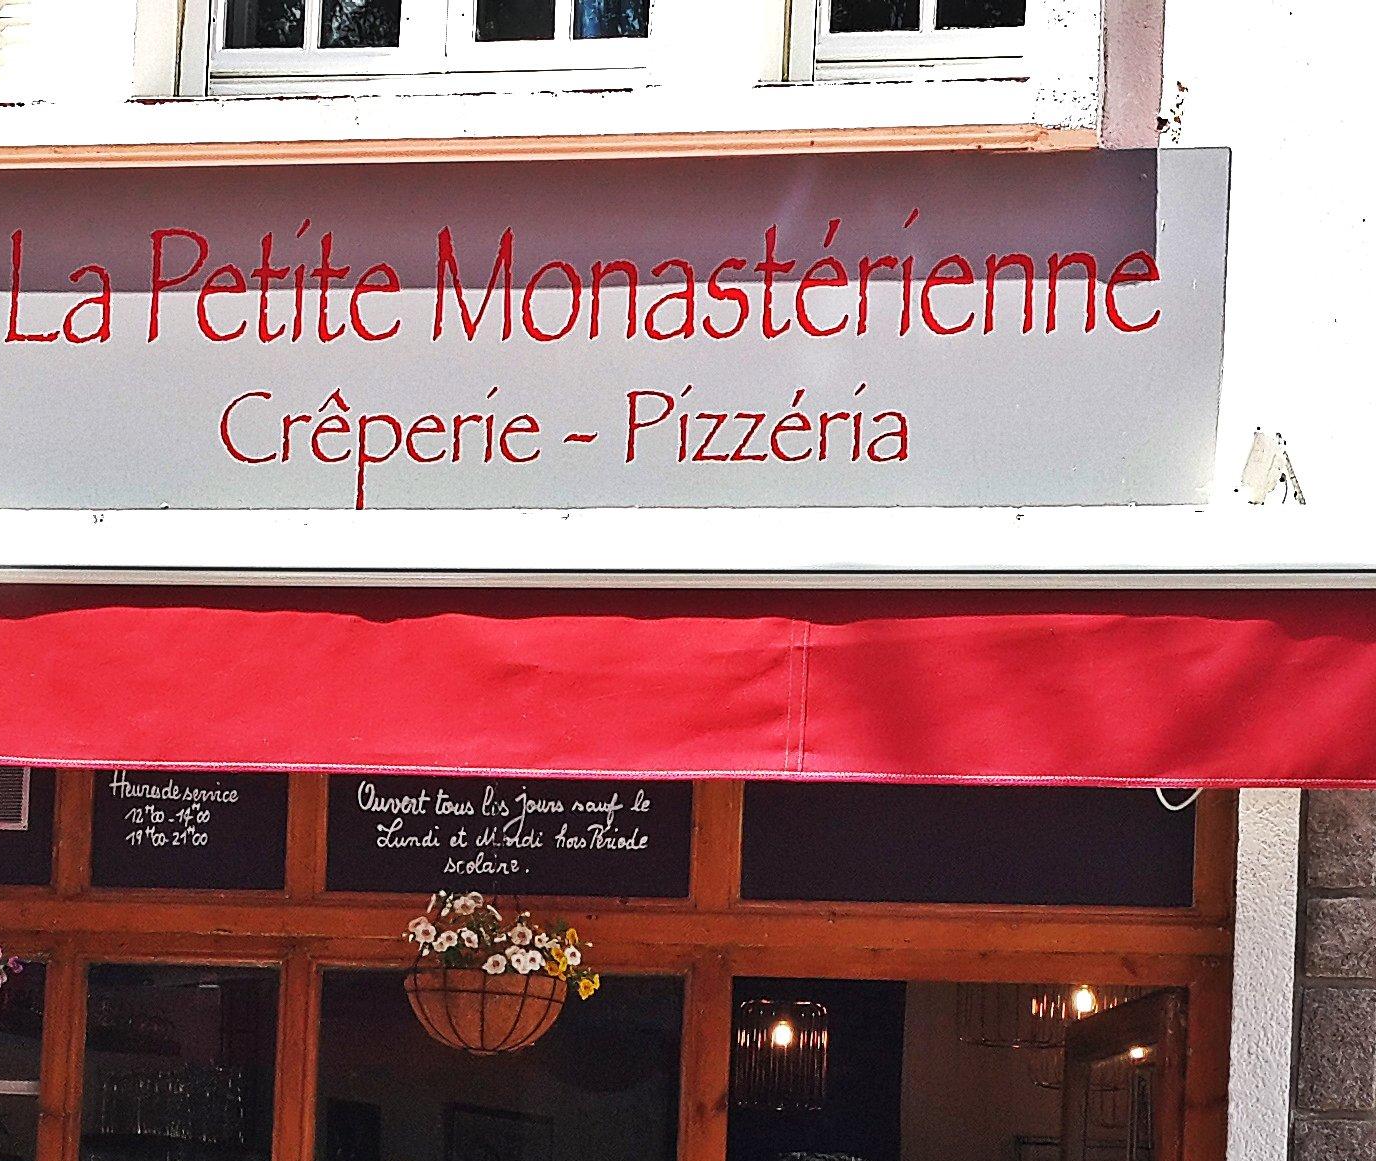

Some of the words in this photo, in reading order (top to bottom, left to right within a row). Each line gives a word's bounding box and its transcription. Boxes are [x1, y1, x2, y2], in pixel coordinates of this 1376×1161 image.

[7, 229, 112, 344] La
[148, 218, 402, 343] Petite
[432, 208, 1161, 343] Monastérienne
[219, 389, 540, 506] Crêperie
[627, 389, 910, 463] Pizzéria
[182, 781, 240, 803] service
[357, 780, 432, 815] Ouvert
[435, 788, 475, 816] tous
[503, 785, 565, 838] jours
[571, 792, 624, 827] sauf
[630, 788, 651, 812] le
[376, 817, 441, 848] Lundi
[449, 826, 469, 848] et
